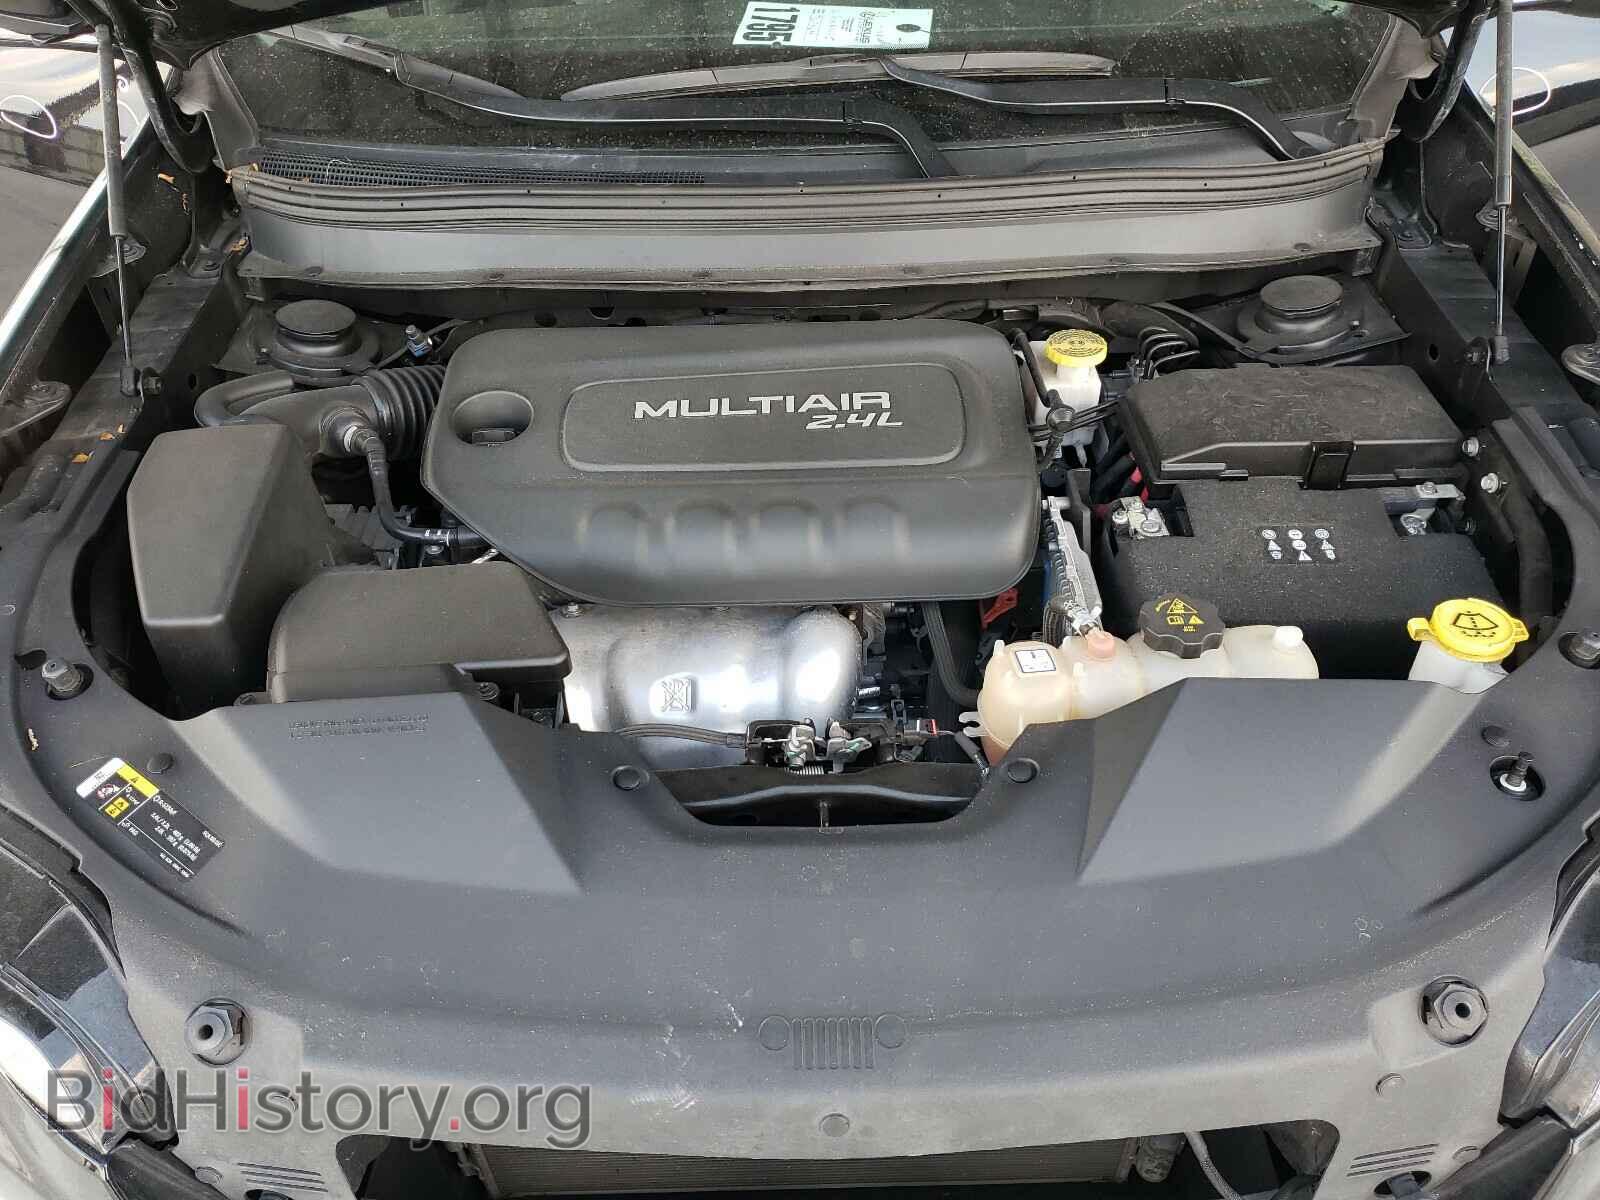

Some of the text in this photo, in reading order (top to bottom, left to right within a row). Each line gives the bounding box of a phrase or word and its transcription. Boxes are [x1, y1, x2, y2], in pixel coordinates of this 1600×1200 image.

[742, 7, 800, 41] 1795
[634, 391, 891, 419] MULTIAIR
[805, 411, 903, 430] 2.4L
